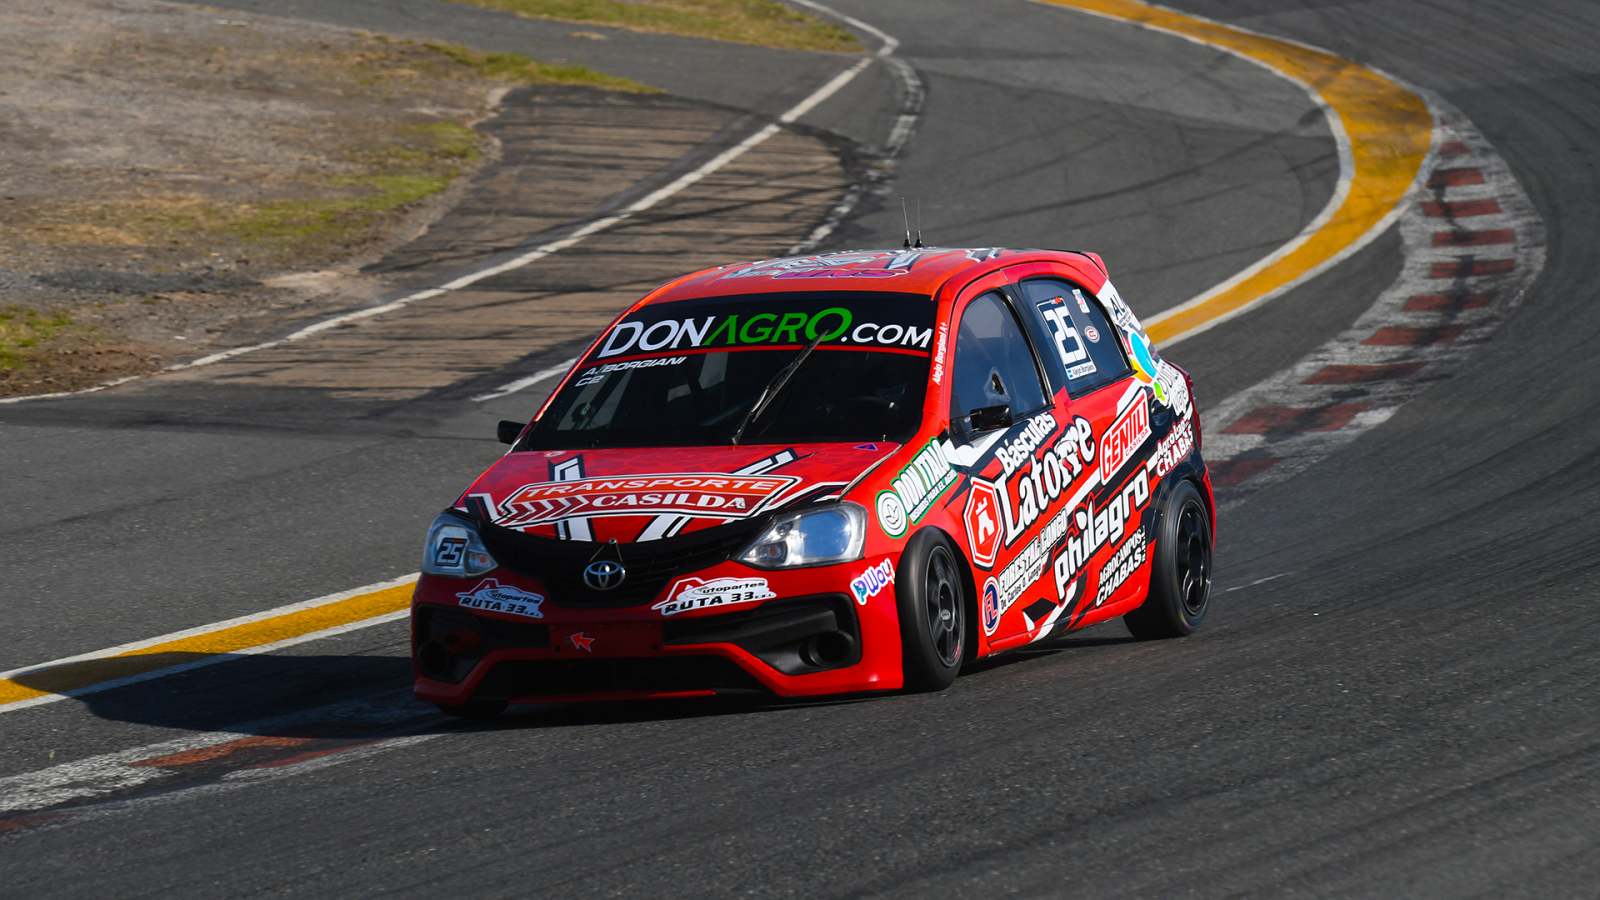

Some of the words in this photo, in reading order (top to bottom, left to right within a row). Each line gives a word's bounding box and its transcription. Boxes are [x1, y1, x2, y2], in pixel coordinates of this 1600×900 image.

[598, 307, 934, 358] DONAGRO.COM
[1043, 306, 1086, 364] 25
[934, 331, 947, 364] Borgiani
[601, 356, 687, 373] BORGIANI
[932, 363, 943, 386] Alejo
[575, 374, 605, 387] C2
[994, 411, 1057, 478] Básculas
[1125, 428, 1149, 457] CASILDA
[525, 478, 782, 498] TRANSPORTE
[892, 464, 929, 515] DON
[912, 439, 952, 495] ITALO
[591, 493, 747, 509] CASILDA
[1054, 468, 1149, 600] philagro
[436, 542, 464, 564] 25
[998, 535, 1041, 598] FORESTAL
[461, 597, 501, 611] RUTA
[664, 595, 723, 614] RUTA
